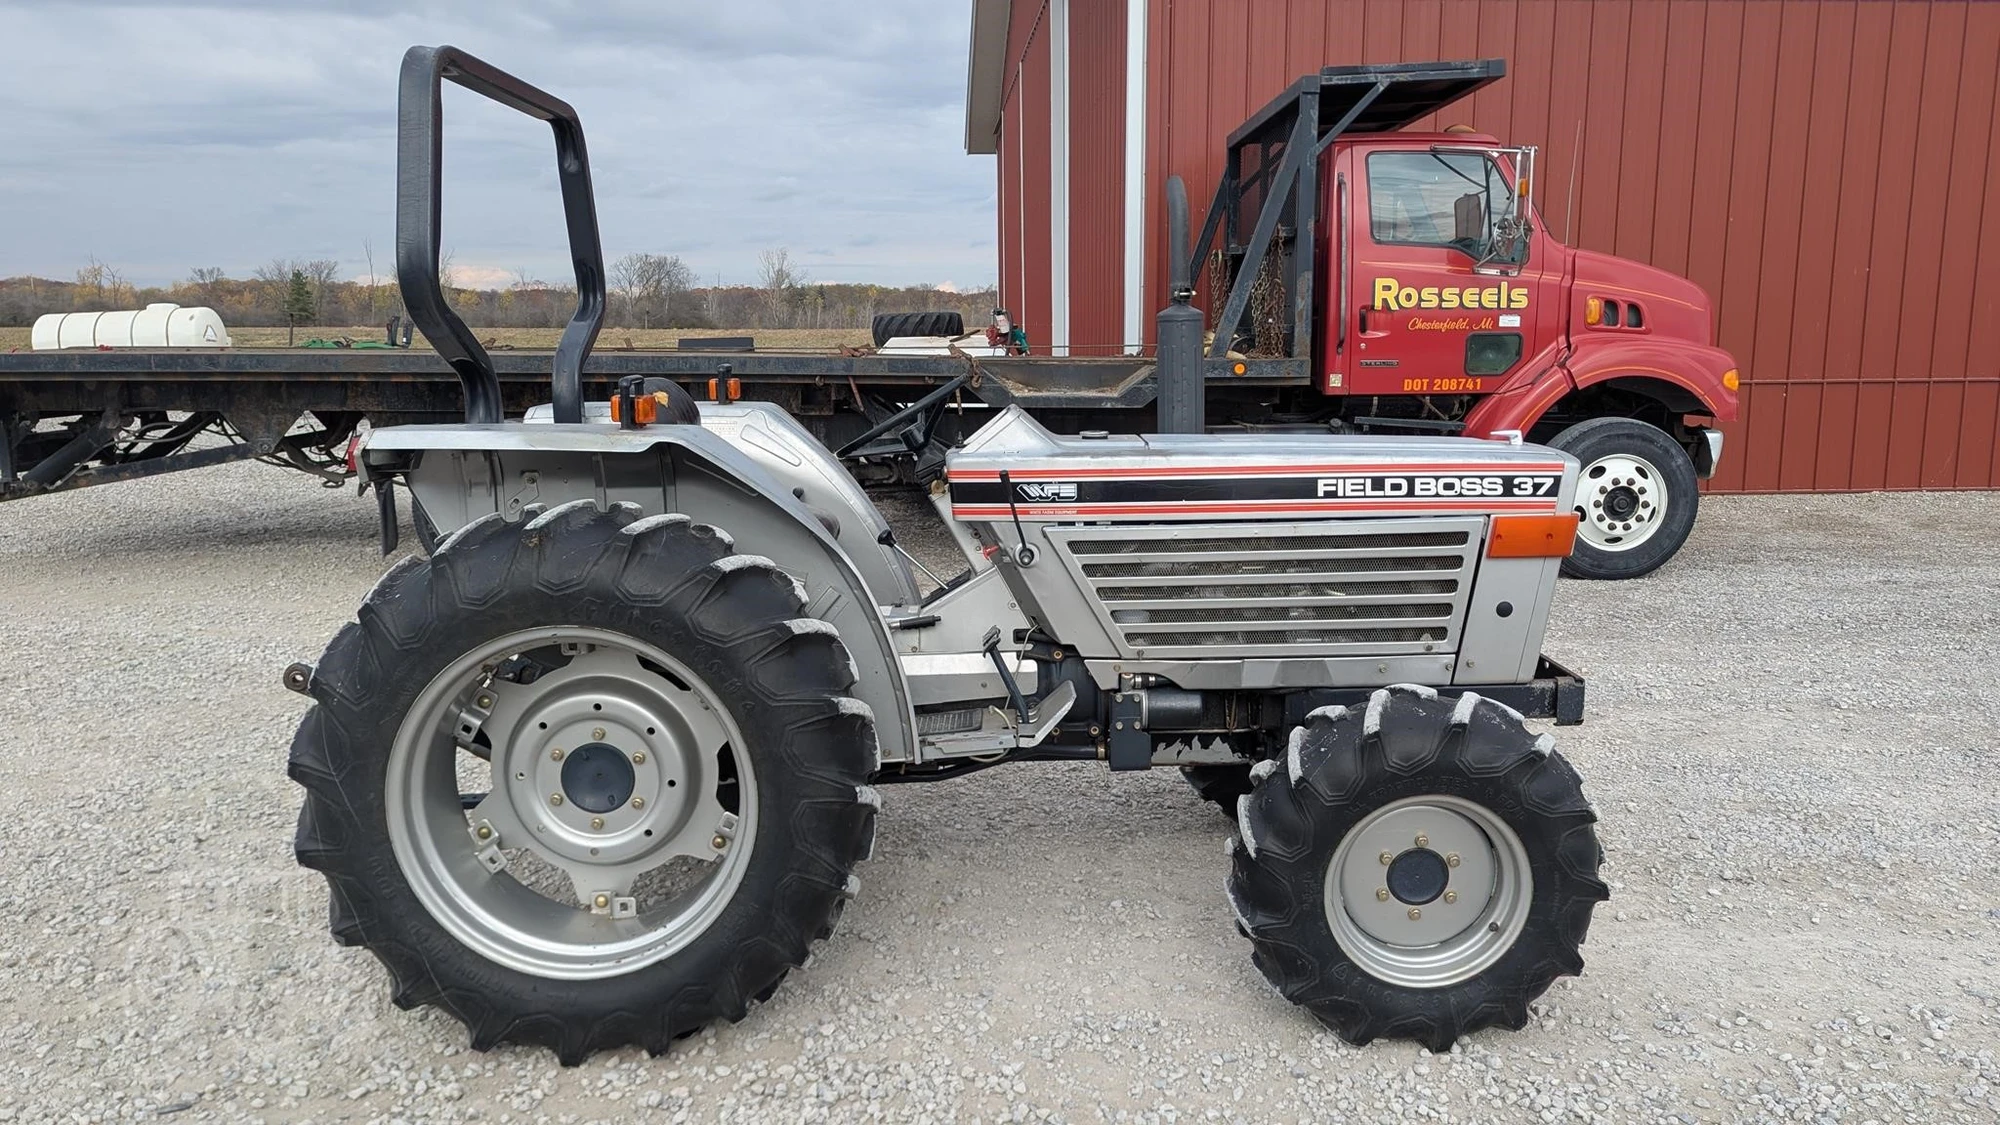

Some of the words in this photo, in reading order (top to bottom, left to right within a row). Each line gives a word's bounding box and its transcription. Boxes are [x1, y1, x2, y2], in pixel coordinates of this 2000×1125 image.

[1374, 277, 1529, 311] Rosseels
[1403, 378, 1429, 391] DOT
[1433, 378, 1482, 391] 208741
[1317, 478, 1408, 497] FIELD
[1414, 478, 1504, 496] BOSS
[1512, 477, 1555, 496] 37
